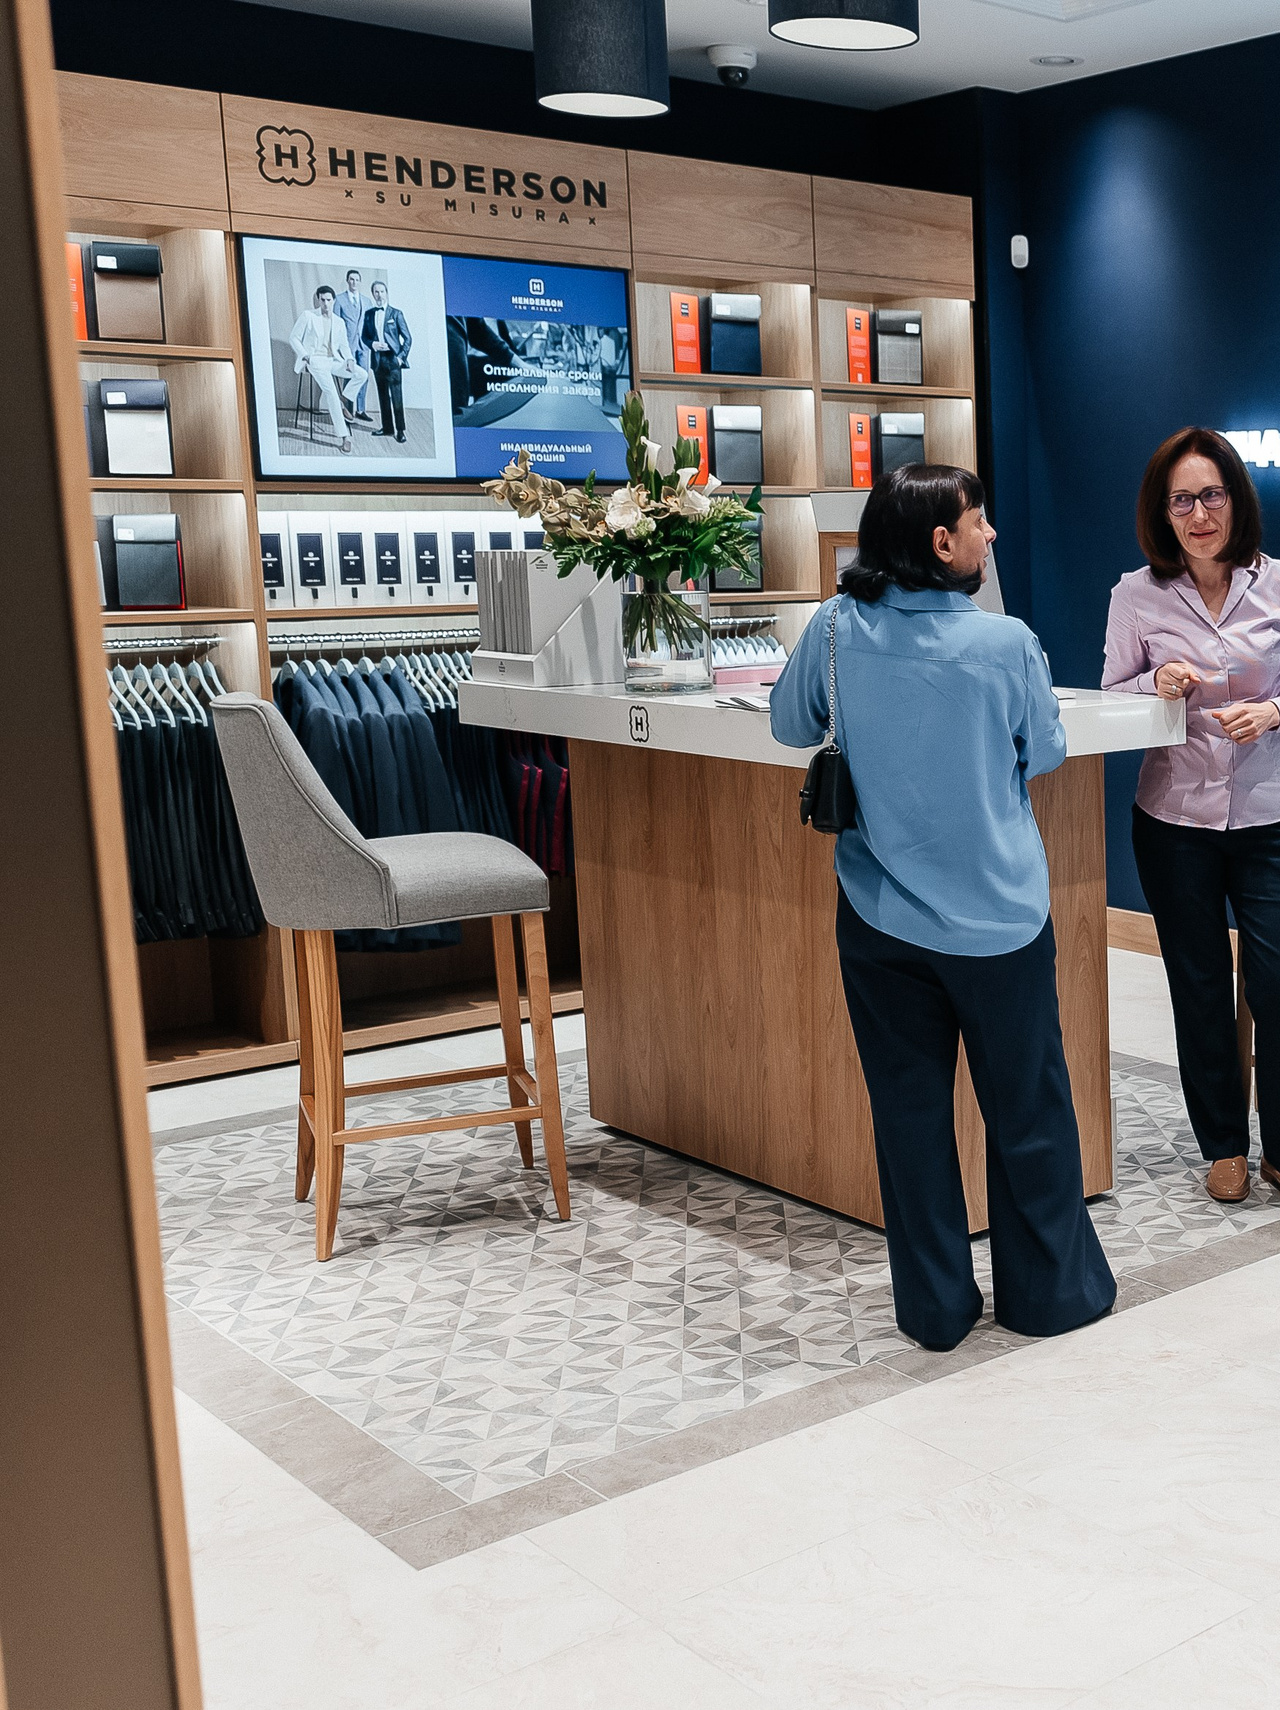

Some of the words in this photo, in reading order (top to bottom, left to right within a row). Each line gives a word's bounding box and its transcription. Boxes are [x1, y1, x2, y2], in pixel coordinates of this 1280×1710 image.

[273, 143, 299, 169] H
[328, 146, 608, 209] HENDERSON
[375, 190, 412, 207] SU
[444, 198, 570, 225] MISURA
[511, 295, 564, 308] HENDERSON
[483, 363, 567, 379] Оптимальные
[567, 370, 603, 382] сроки
[486, 382, 559, 395] исполнения
[562, 386, 601, 397] заказа
[500, 442, 592, 454] ИНДИВИДУАЛЬНЫЙ
